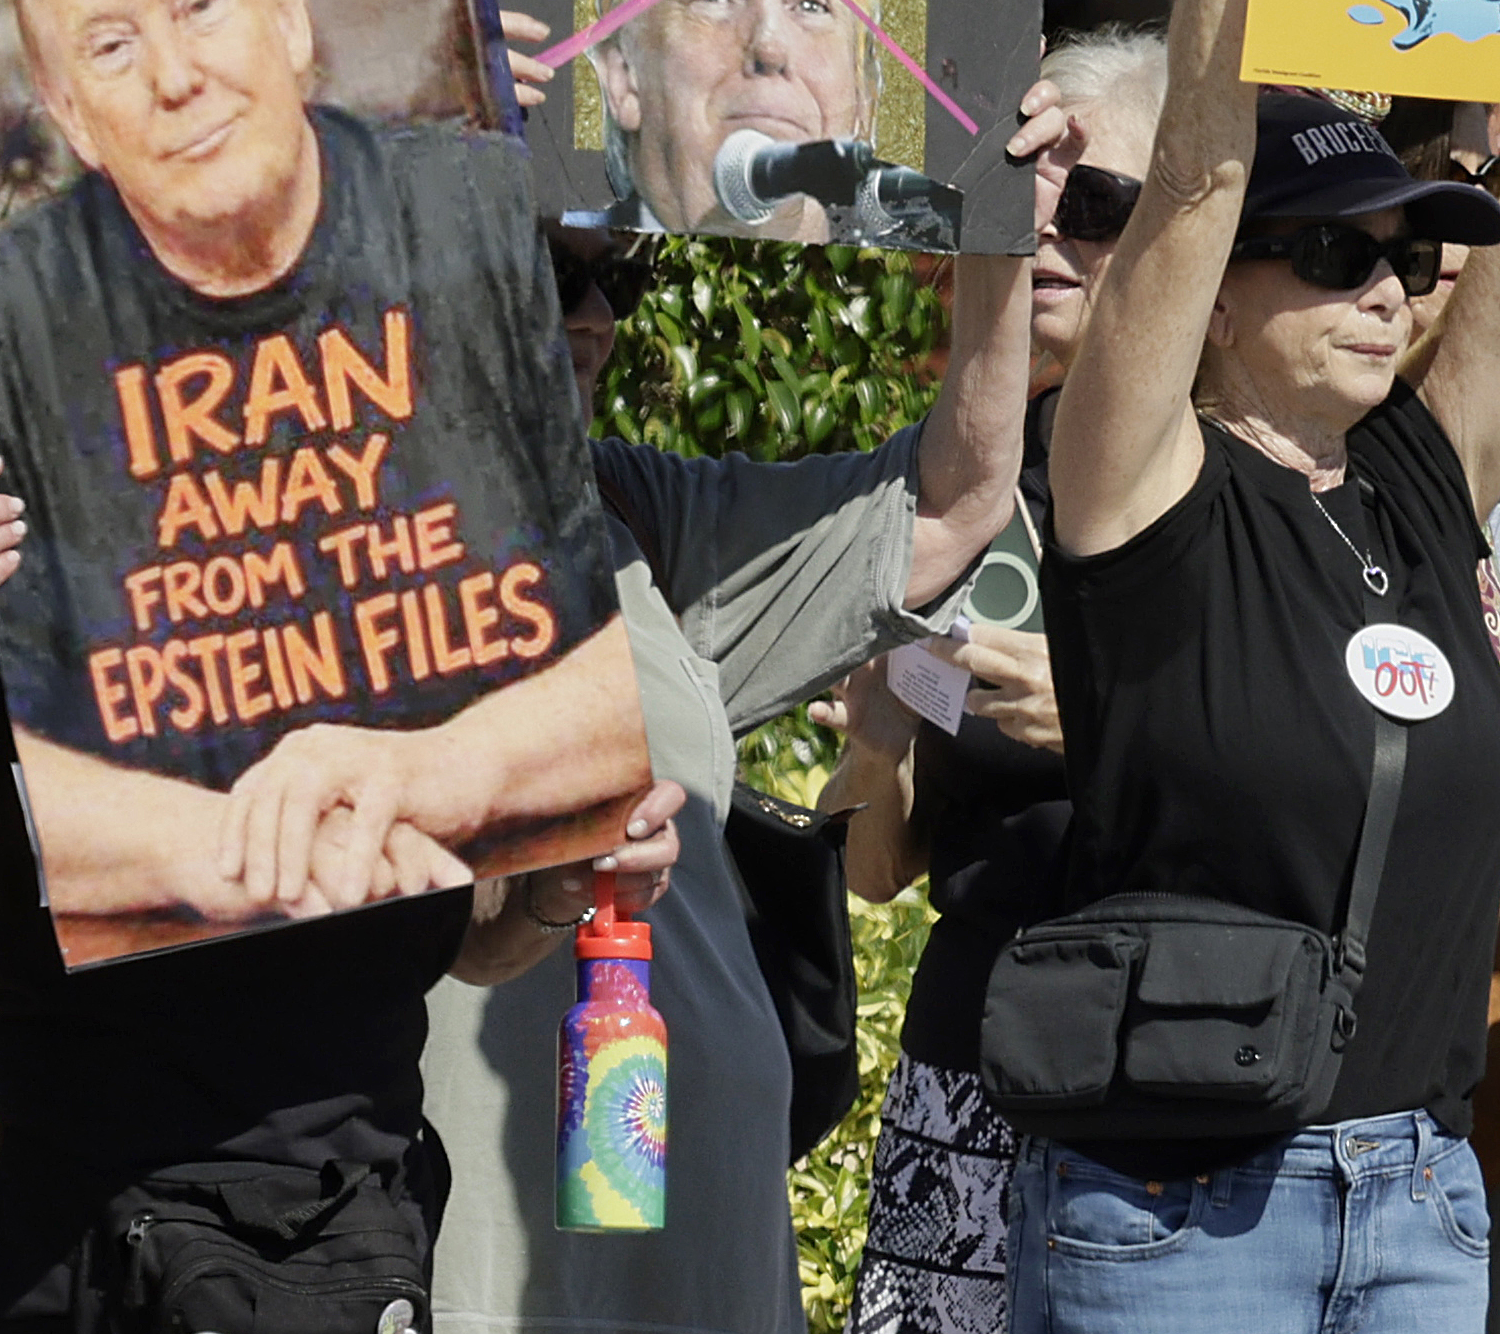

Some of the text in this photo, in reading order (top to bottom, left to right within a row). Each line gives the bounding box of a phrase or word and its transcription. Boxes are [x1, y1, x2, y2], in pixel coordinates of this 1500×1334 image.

[115, 311, 413, 477] IRAN
[159, 435, 387, 547] AWAY
[125, 503, 465, 632] FROM THE
[89, 563, 555, 743] EPSTEIN FILES
[1375, 661, 1435, 705] OUT!
